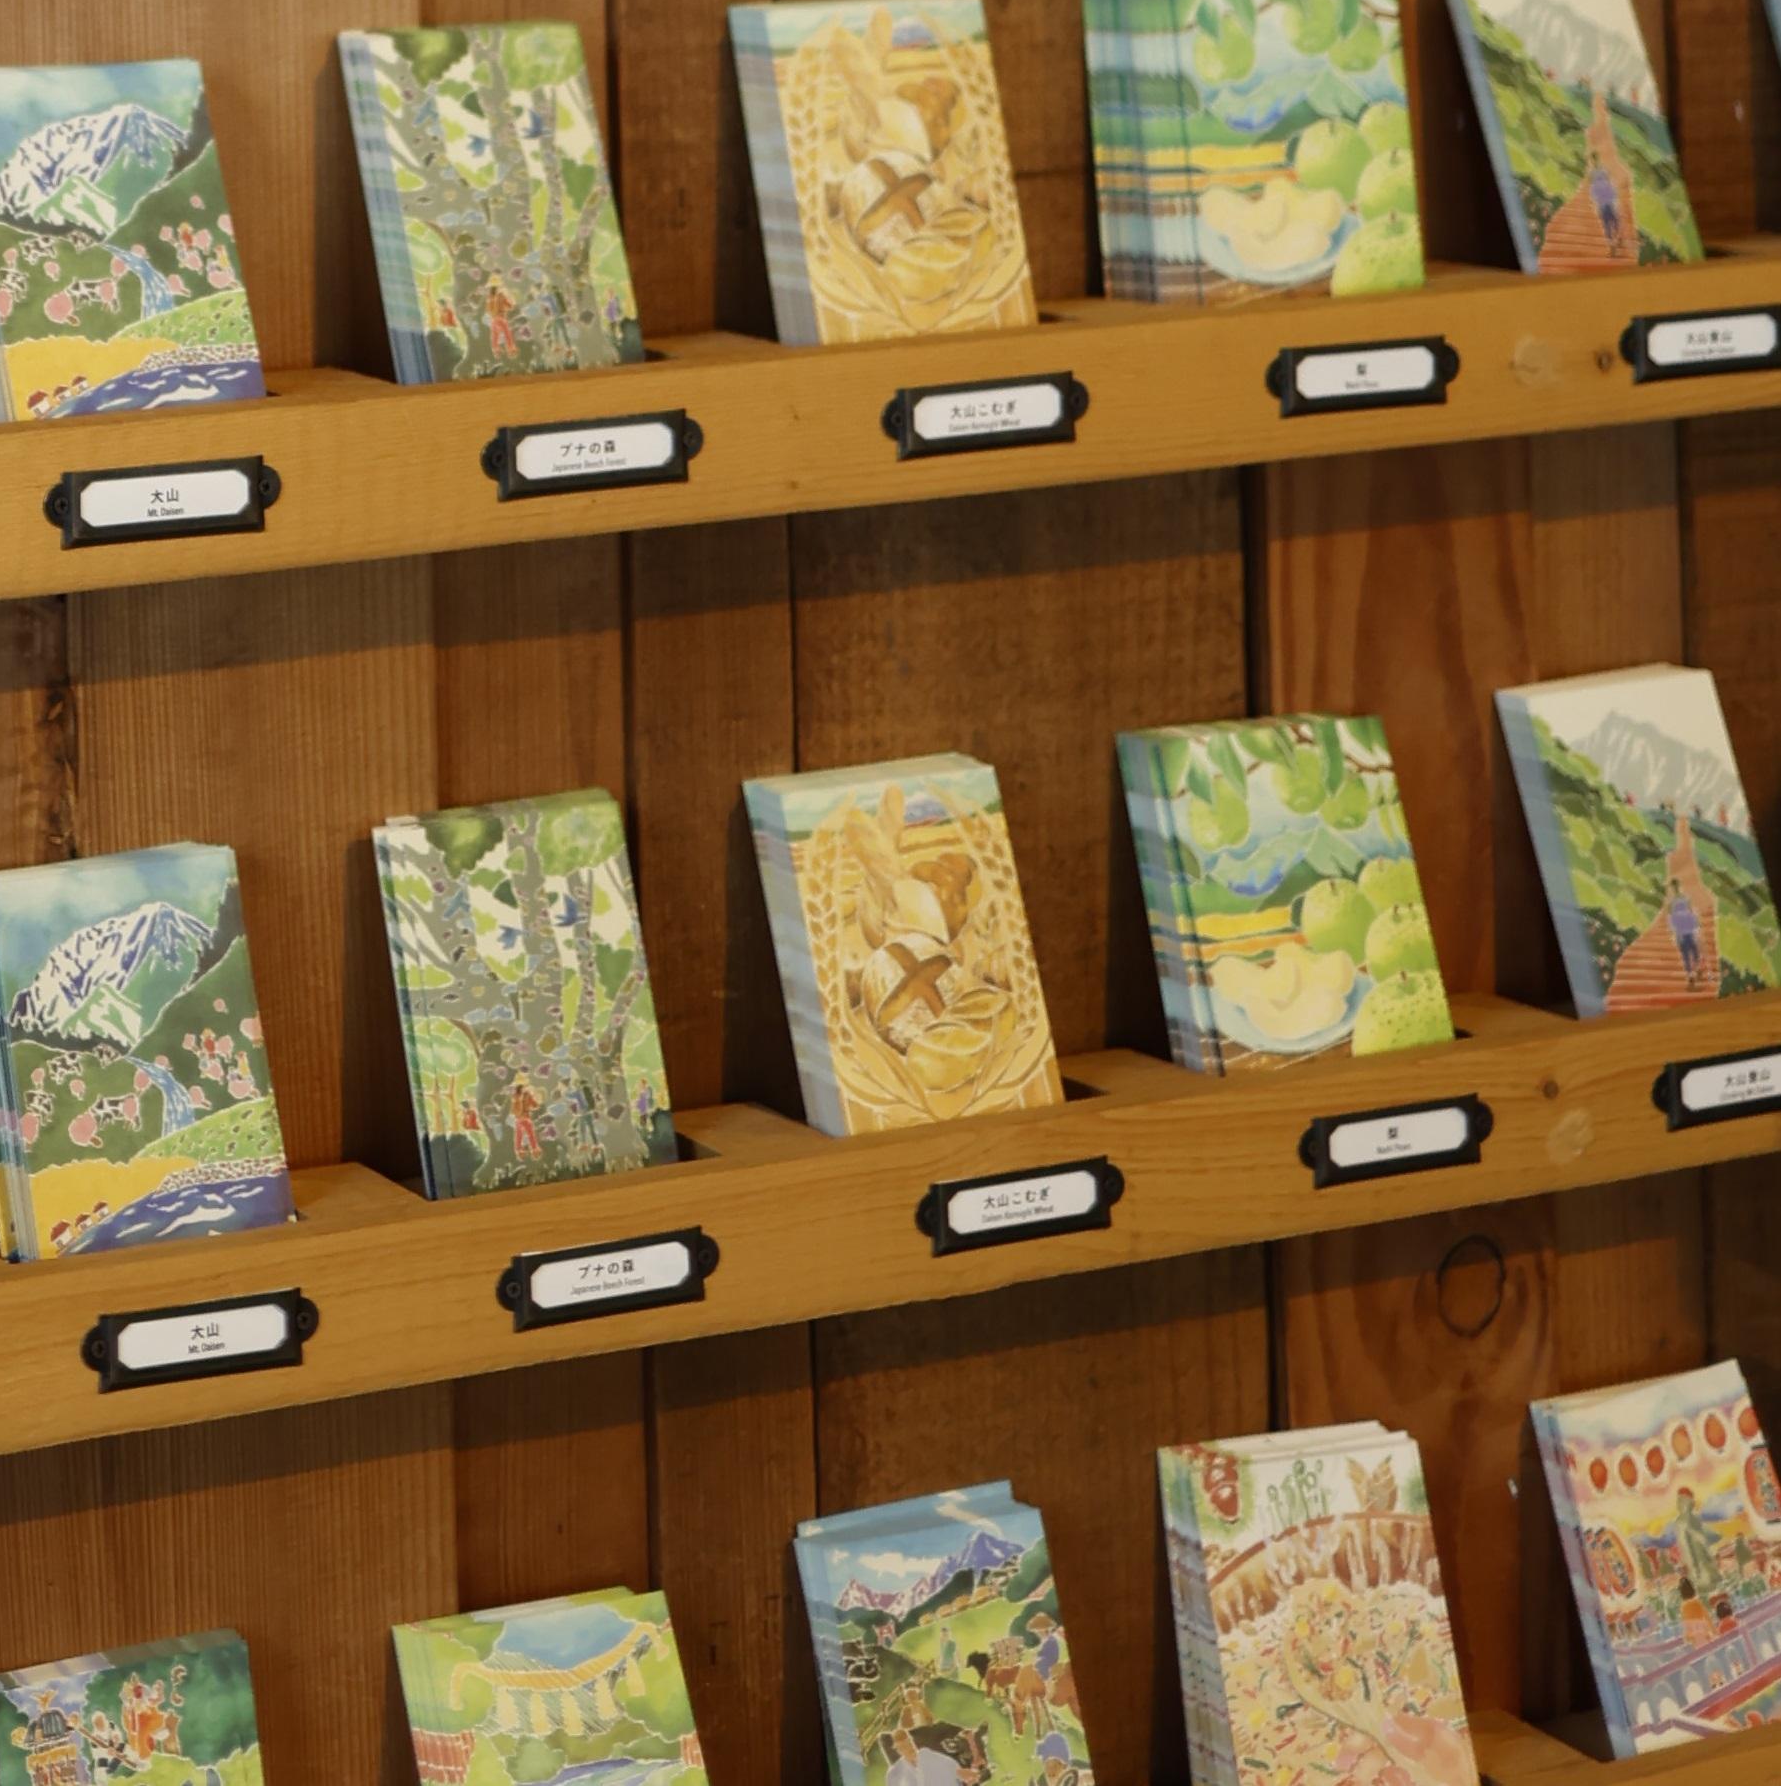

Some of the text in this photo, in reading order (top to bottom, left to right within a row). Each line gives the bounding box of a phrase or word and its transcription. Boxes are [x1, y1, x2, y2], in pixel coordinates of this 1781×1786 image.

[950, 399, 1017, 420] 大山こむぎ
[559, 439, 616, 459] ブナの森
[150, 487, 180, 505] 大山
[161, 505, 185, 518] Daisen
[983, 1185, 1052, 1211] 大山こむぎ
[577, 1258, 635, 1280] ブナの森
[190, 1321, 220, 1341] 大山
